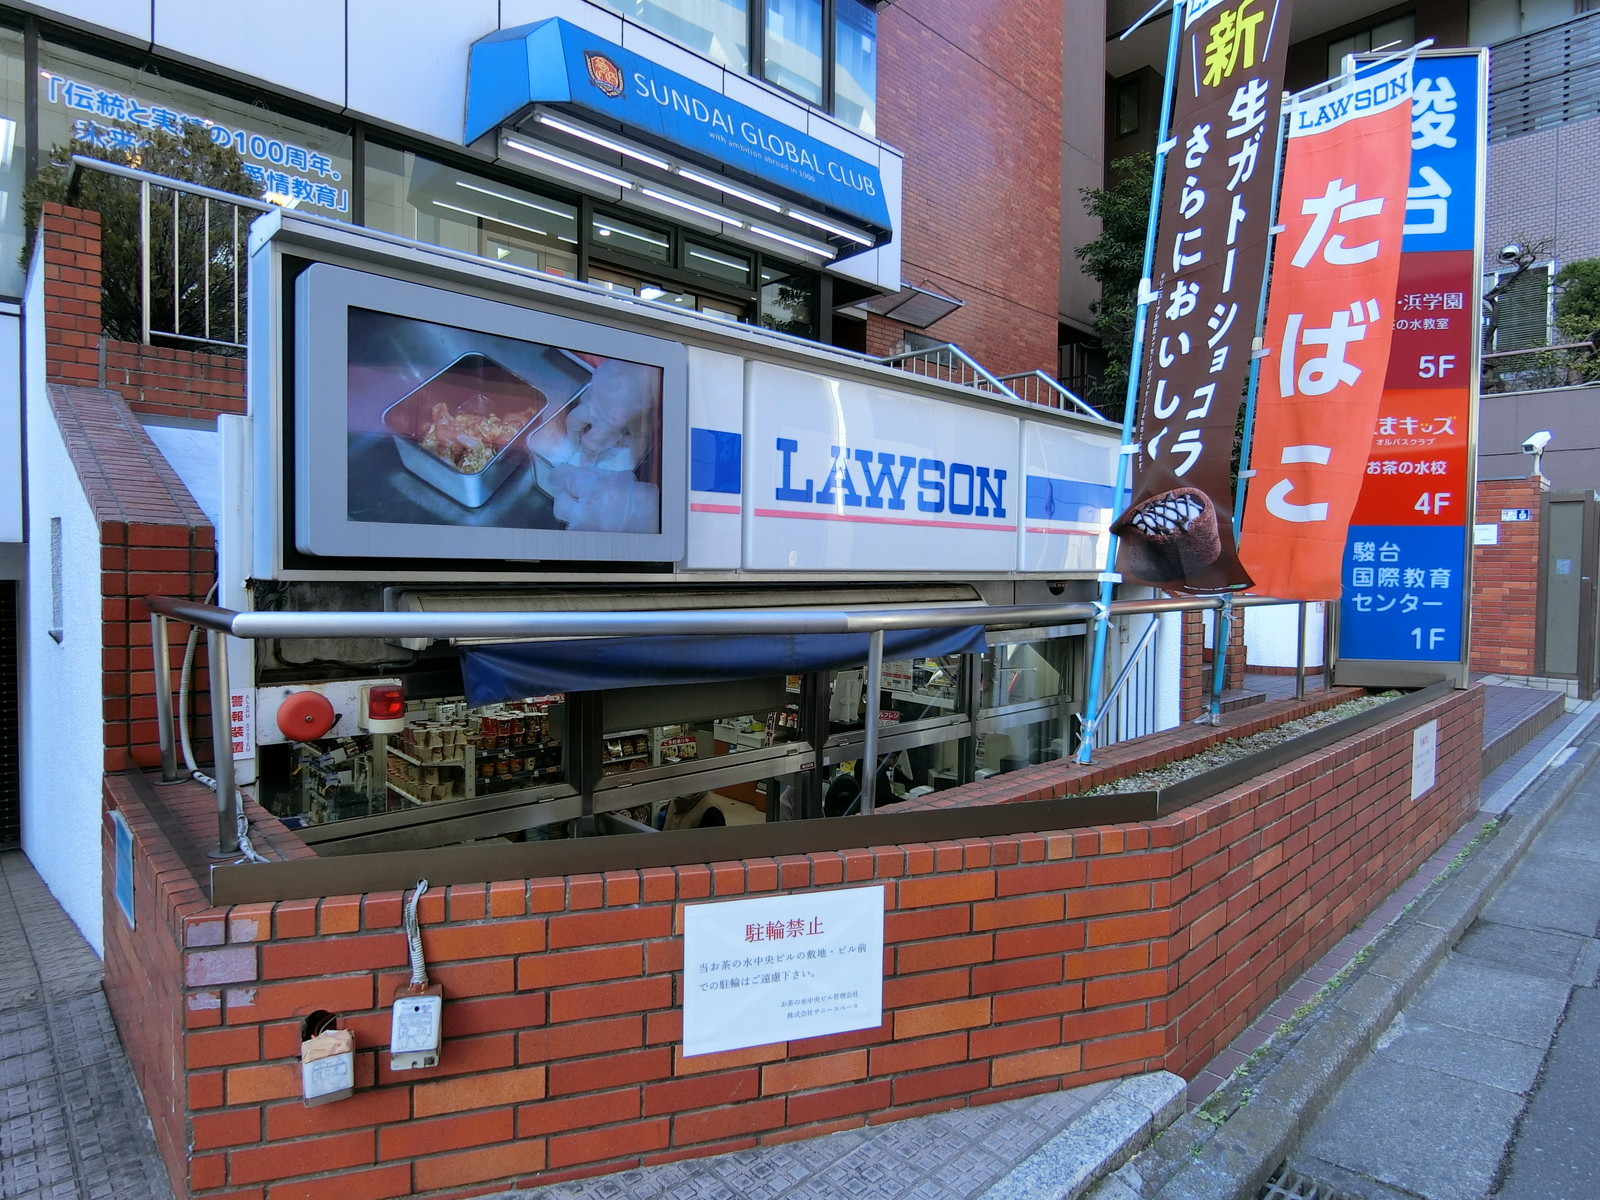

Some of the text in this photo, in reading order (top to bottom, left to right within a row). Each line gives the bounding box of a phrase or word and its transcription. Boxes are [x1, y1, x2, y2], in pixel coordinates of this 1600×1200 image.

[1202, 0, 1265, 87] 新
[1299, 72, 1408, 130] LAWSON
[633, 72, 734, 136] SUNDAI
[740, 122, 825, 176] GLOBAL
[828, 161, 877, 197] CLUB
[708, 131, 727, 144] with
[728, 140, 763, 160] ambition
[764, 155, 789, 171] abroad
[790, 166, 798, 175] in
[1170, 78, 1270, 477] 生ガトーショコラ
[1146, 123, 1212, 462] さらにおいしく
[1264, 177, 1382, 524] たばこ
[1417, 355, 1456, 379] 5F
[1374, 415, 1457, 436] まキッズ
[775, 437, 1008, 519] LAWSON
[1366, 460, 1447, 475] お茶の水校
[1413, 493, 1451, 516] 4F
[1352, 541, 1401, 562] 駿台
[1351, 567, 1452, 589] 国際教育
[1351, 592, 1443, 614] センター
[1410, 626, 1446, 650] 1F
[231, 695, 243, 753] 警報装置
[744, 916, 825, 943] 駐輪禁止
[698, 943, 868, 974] 当お茶の水中央ビルの敷地・ビル前
[698, 969, 816, 992] での駐輪はご遠慮下さい。
